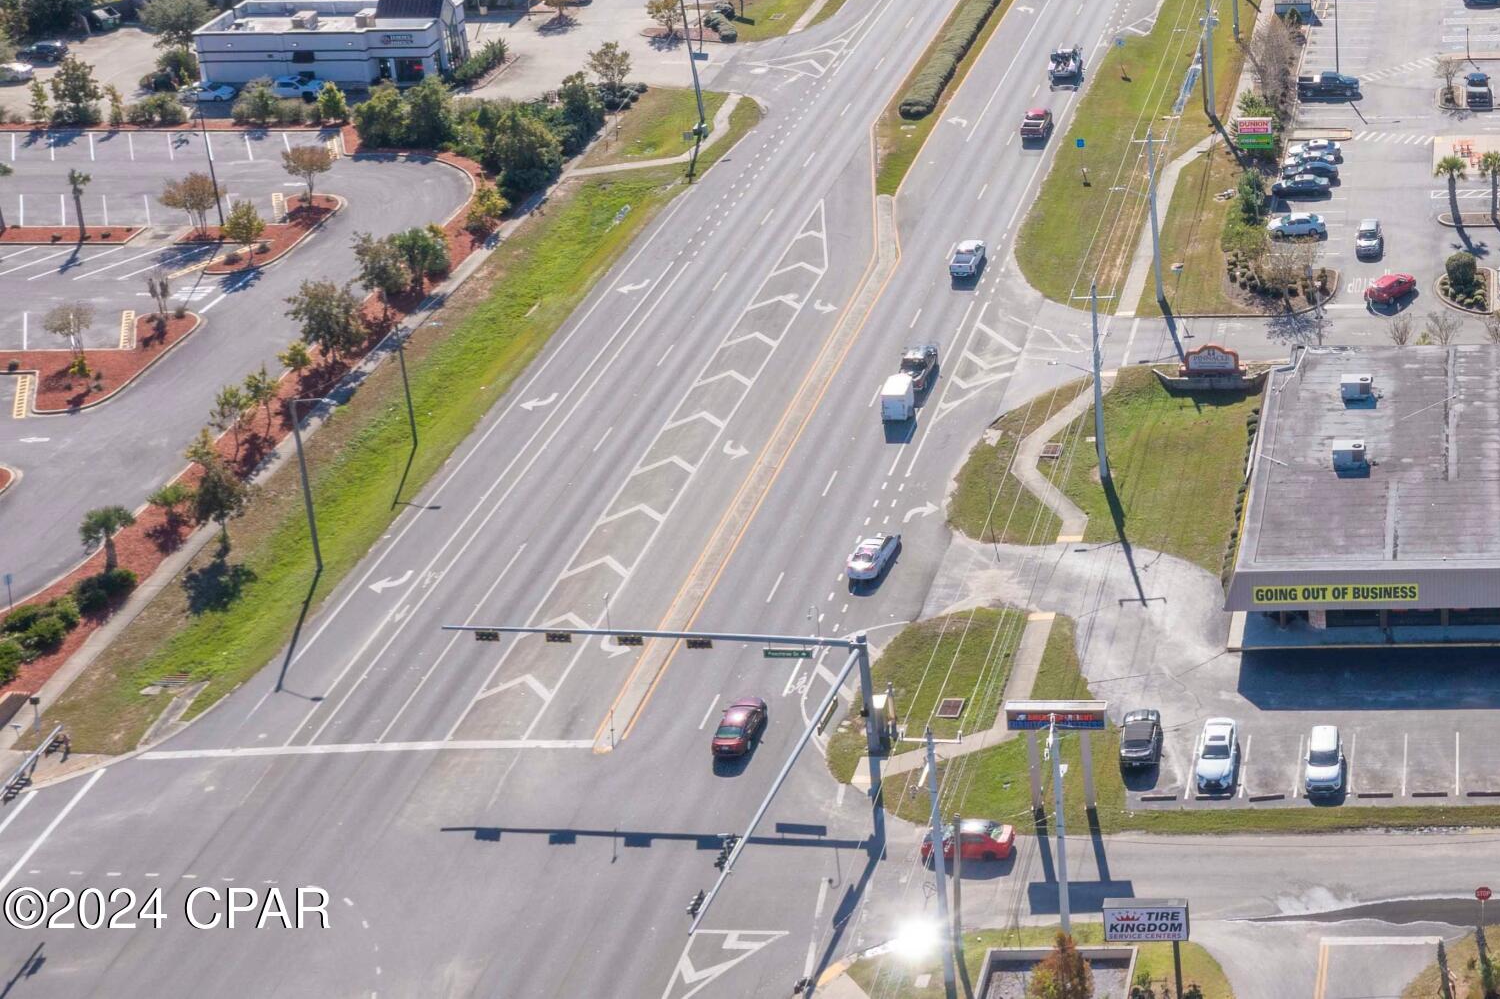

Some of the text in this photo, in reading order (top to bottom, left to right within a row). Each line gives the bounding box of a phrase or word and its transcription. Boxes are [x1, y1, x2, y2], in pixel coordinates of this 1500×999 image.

[1256, 586, 1417, 601] GOING OUT OF BUSINESS
[1146, 911, 1180, 921] TIRE
[1109, 923, 1182, 933] KINGDOM
